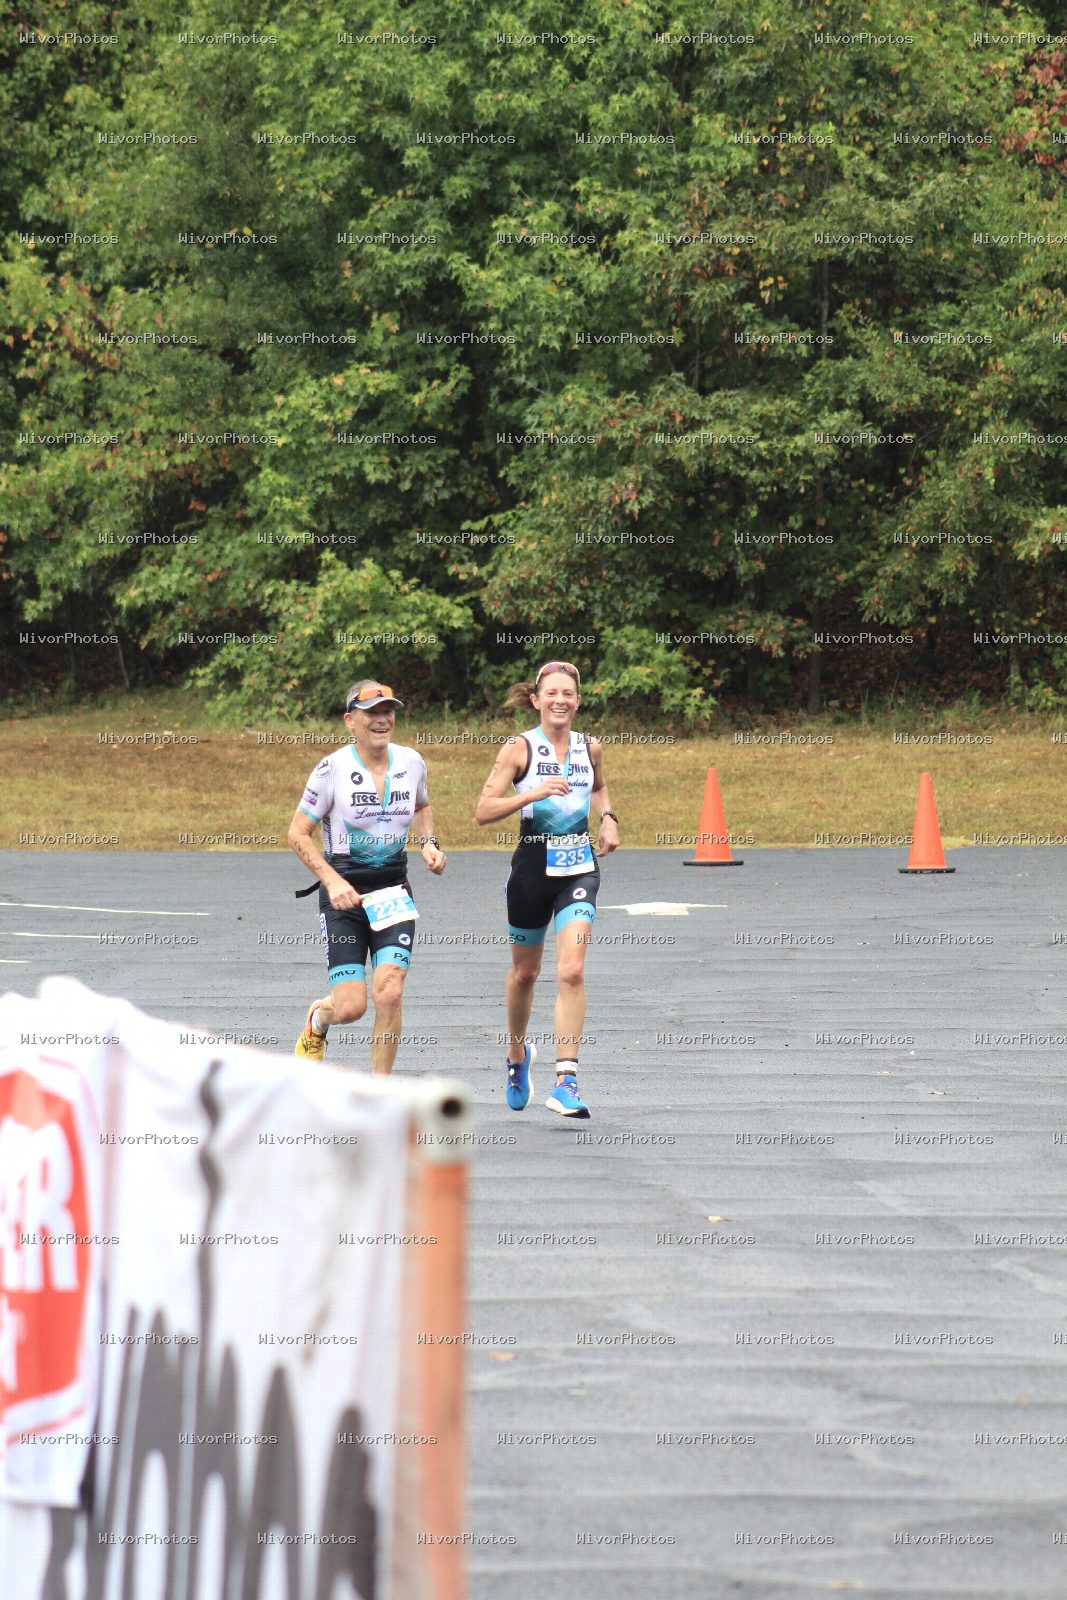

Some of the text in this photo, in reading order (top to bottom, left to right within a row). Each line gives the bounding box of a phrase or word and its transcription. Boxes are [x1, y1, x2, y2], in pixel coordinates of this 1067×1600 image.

[555, 847, 586, 866] 235
[373, 897, 409, 920] 224
[393, 952, 410, 965] PA
